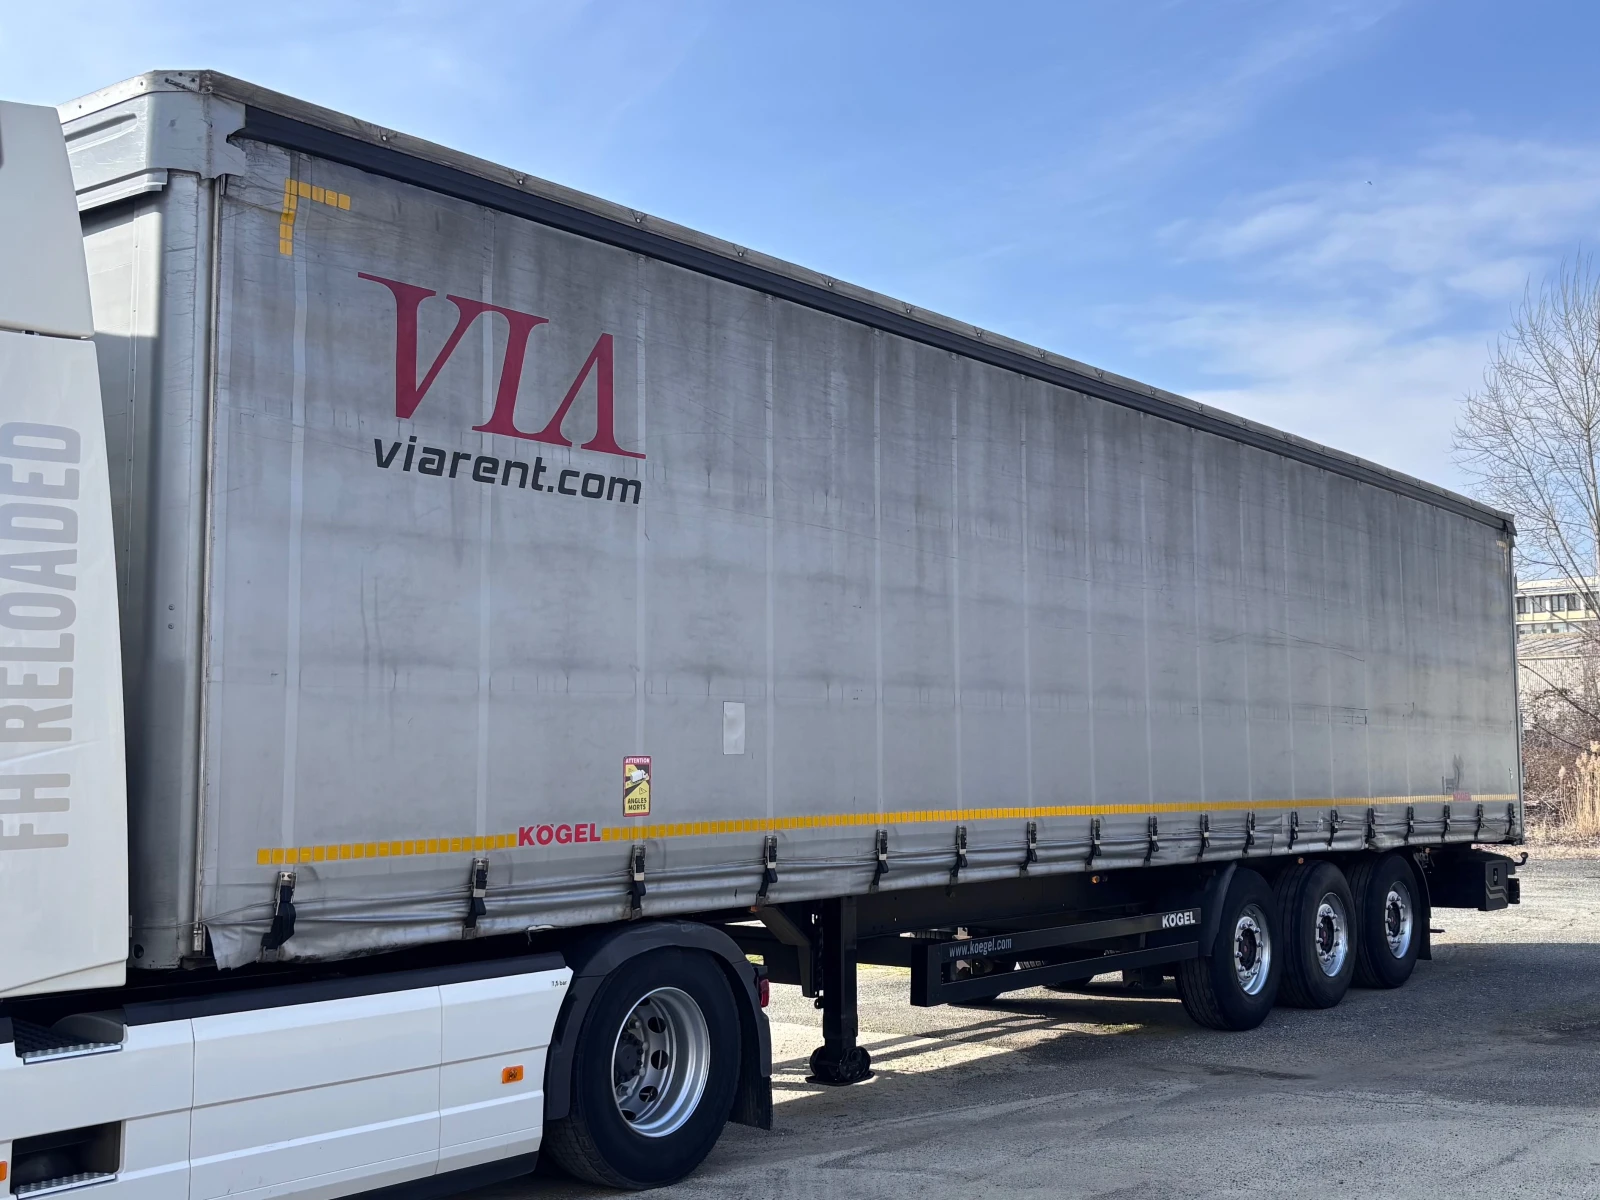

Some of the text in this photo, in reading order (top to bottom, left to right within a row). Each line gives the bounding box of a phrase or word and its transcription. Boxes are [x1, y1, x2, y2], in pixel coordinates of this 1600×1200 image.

[357, 271, 646, 459] VIA
[373, 435, 642, 504] viarent.com
[0, 422, 81, 850] FH RELOADED
[518, 823, 601, 847] KÖGEL
[1162, 911, 1196, 928] KÖGEL
[949, 938, 1012, 958] www.koegel.com
